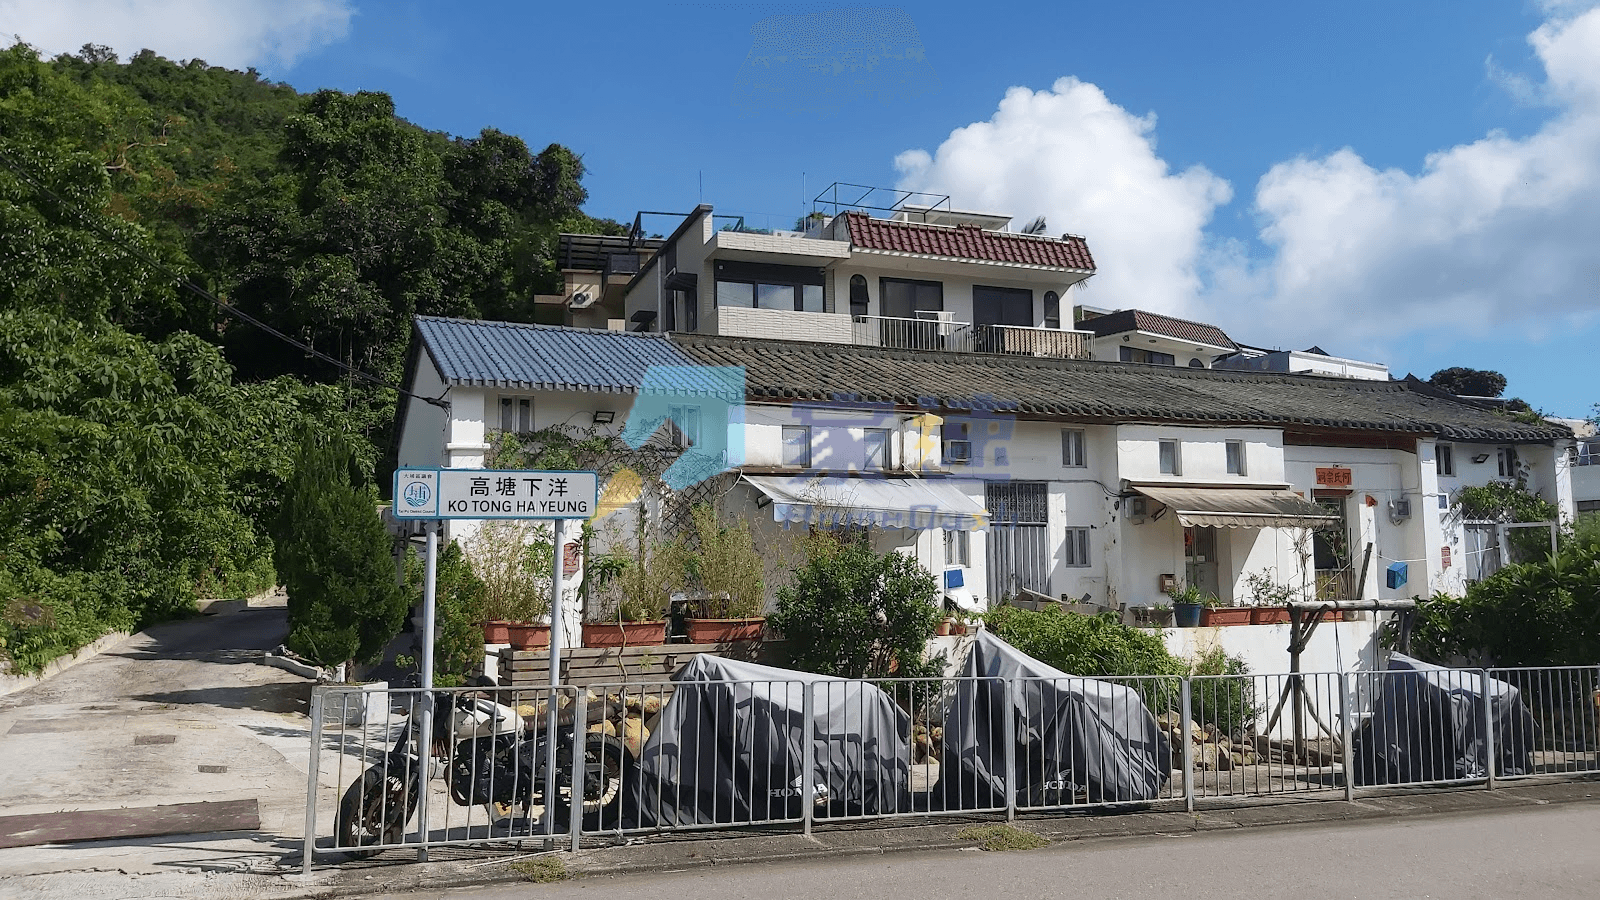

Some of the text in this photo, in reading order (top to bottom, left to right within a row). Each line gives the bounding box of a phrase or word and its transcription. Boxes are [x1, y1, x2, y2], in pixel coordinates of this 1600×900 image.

[469, 476, 569, 497] 高塘下洋
[448, 500, 588, 513] KO TONG HA YEUNG
